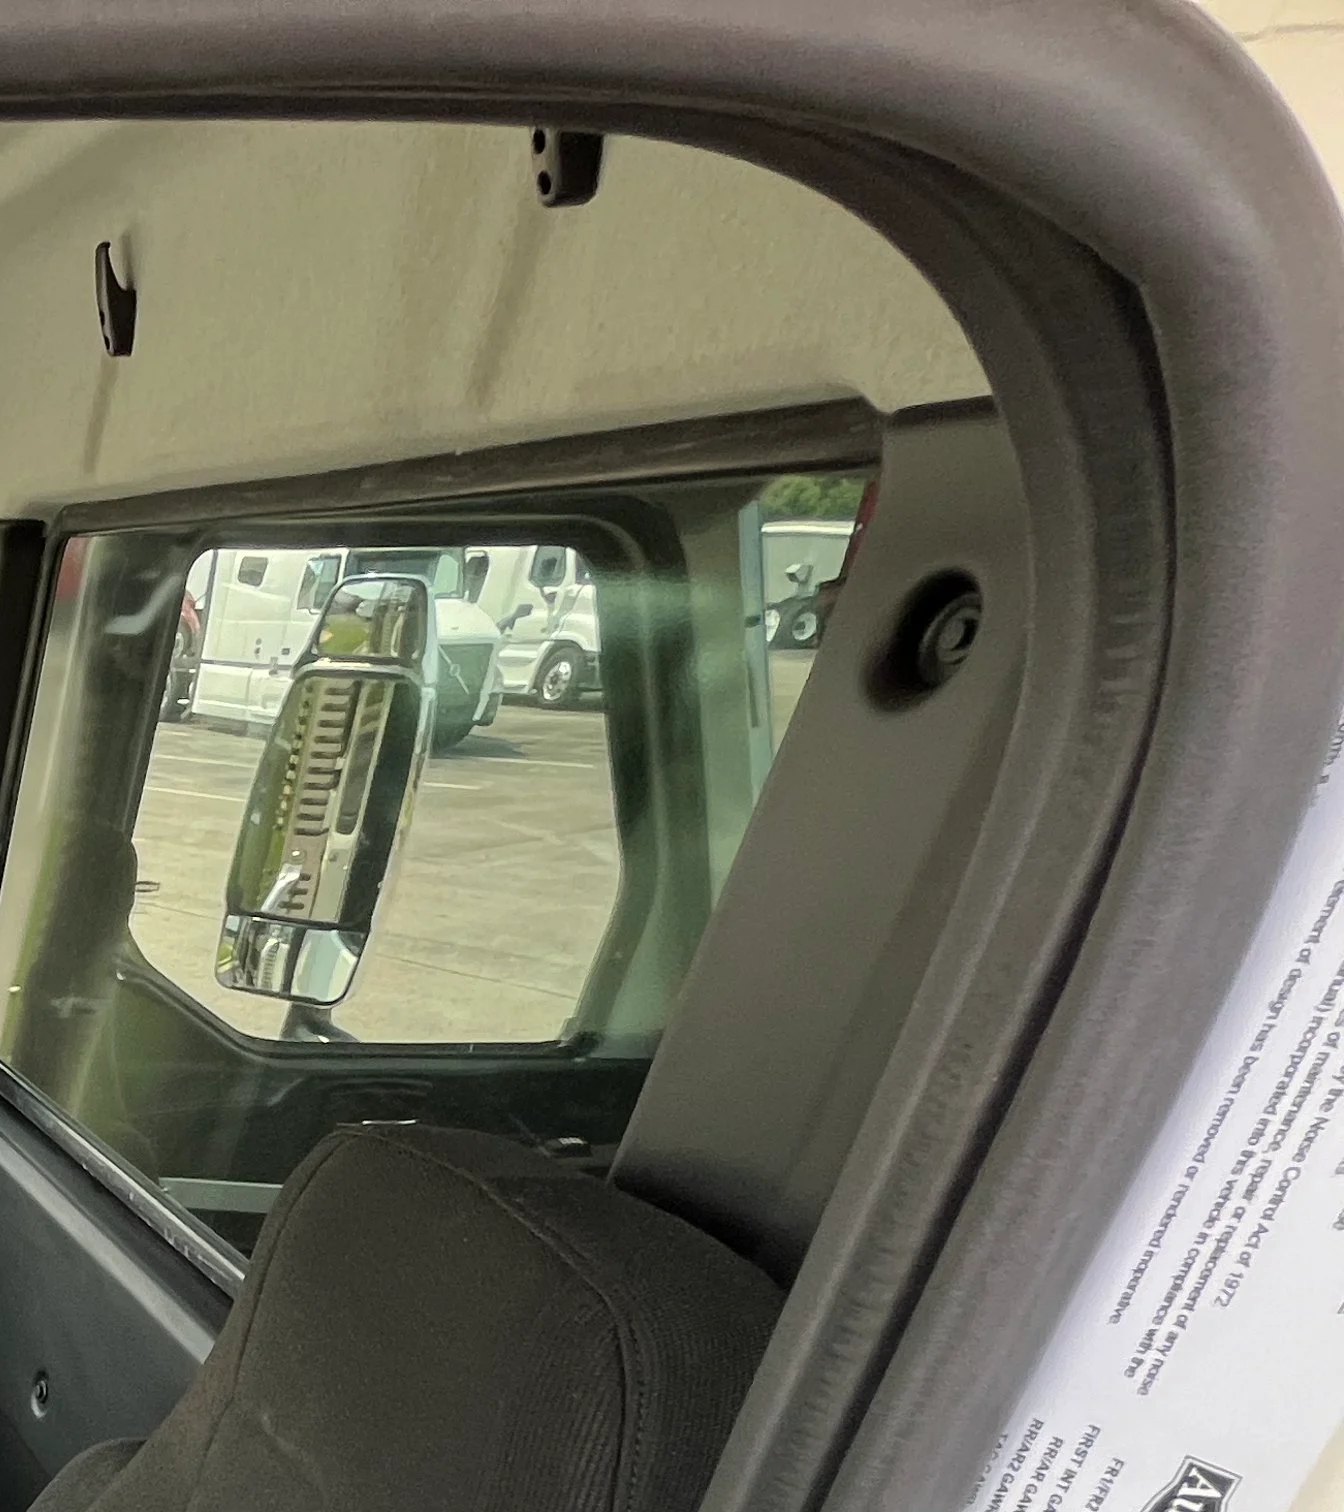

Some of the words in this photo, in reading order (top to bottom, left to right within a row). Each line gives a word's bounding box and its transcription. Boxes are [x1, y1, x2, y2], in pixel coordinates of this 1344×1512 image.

[1295, 948, 1312, 964] of
[1266, 968, 1302, 1020] design
[1249, 1023, 1276, 1052] has
[1322, 1031, 1341, 1049] of
[1227, 1055, 1258, 1095] been
[1262, 1015, 1324, 1116] incorporated
[1262, 1051, 1330, 1154] maintenance,
[1319, 1088, 1342, 1113] the
[1192, 1097, 1235, 1164] removed
[1247, 1118, 1271, 1146] into
[1291, 1116, 1326, 1163] Noise
[1184, 1165, 1199, 1182] or
[1230, 1149, 1257, 1176] this
[1202, 1179, 1238, 1230] vehicle
[1259, 1166, 1299, 1221] Control
[1148, 1184, 1190, 1249] rendered
[1193, 1231, 1210, 1245] in
[1244, 1222, 1266, 1249] Act
[1181, 1224, 1237, 1312] replacement
[1236, 1250, 1251, 1266] of
[1213, 1272, 1239, 1306] 1972
[1172, 1314, 1188, 1328] of
[1136, 1328, 1158, 1355] with
[1149, 1330, 1178, 1357] any
[1124, 1356, 1142, 1378] the
[1136, 1358, 1164, 1396] noise
[1007, 1418, 1045, 1472] RR/AR2
[1030, 1436, 1064, 1482] RR/AR
[1070, 1424, 1101, 1468] FIRST
[1056, 1468, 1078, 1494] INT
[1085, 1457, 1125, 1512] FR1/FR2
